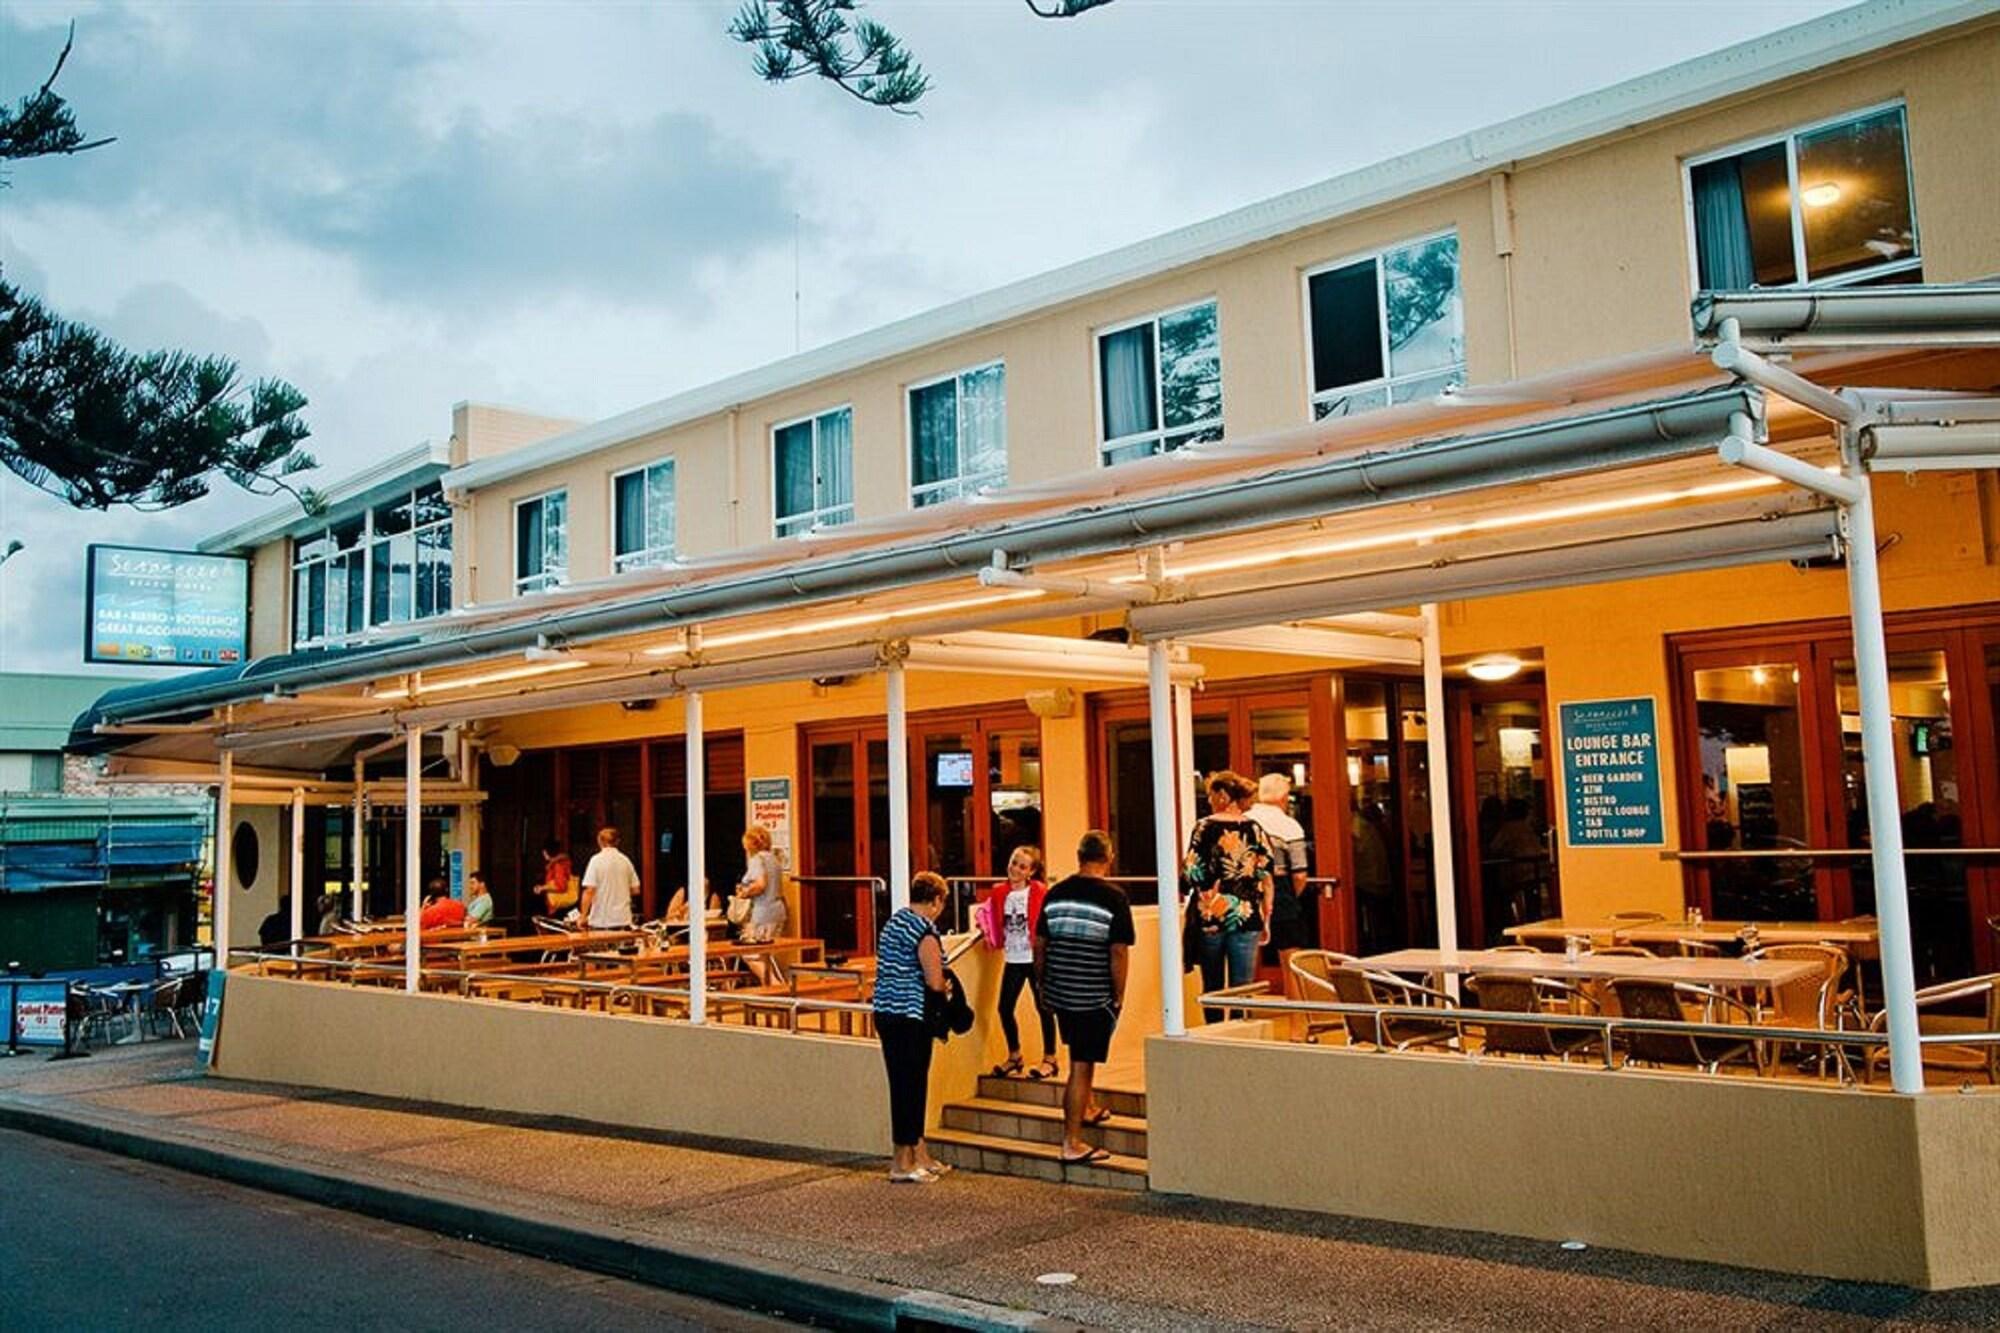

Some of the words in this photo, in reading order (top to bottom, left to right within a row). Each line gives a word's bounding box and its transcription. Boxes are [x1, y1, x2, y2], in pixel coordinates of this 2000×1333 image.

[99, 609, 120, 620] BAR
[96, 622, 133, 634] GREAT
[1567, 735, 1618, 750] LOUNGE
[1622, 733, 1651, 748] BAR
[1575, 751, 1645, 767] ENTRANCE
[1582, 774, 1604, 783] BEER
[1607, 772, 1643, 782] GARDEN
[1584, 796, 1617, 805] BISTRO
[1584, 807, 1613, 816] ROYAL
[1615, 805, 1650, 815] LOUNGE
[1586, 829, 1619, 838] BOTTLE
[1622, 828, 1647, 838] SHOP
